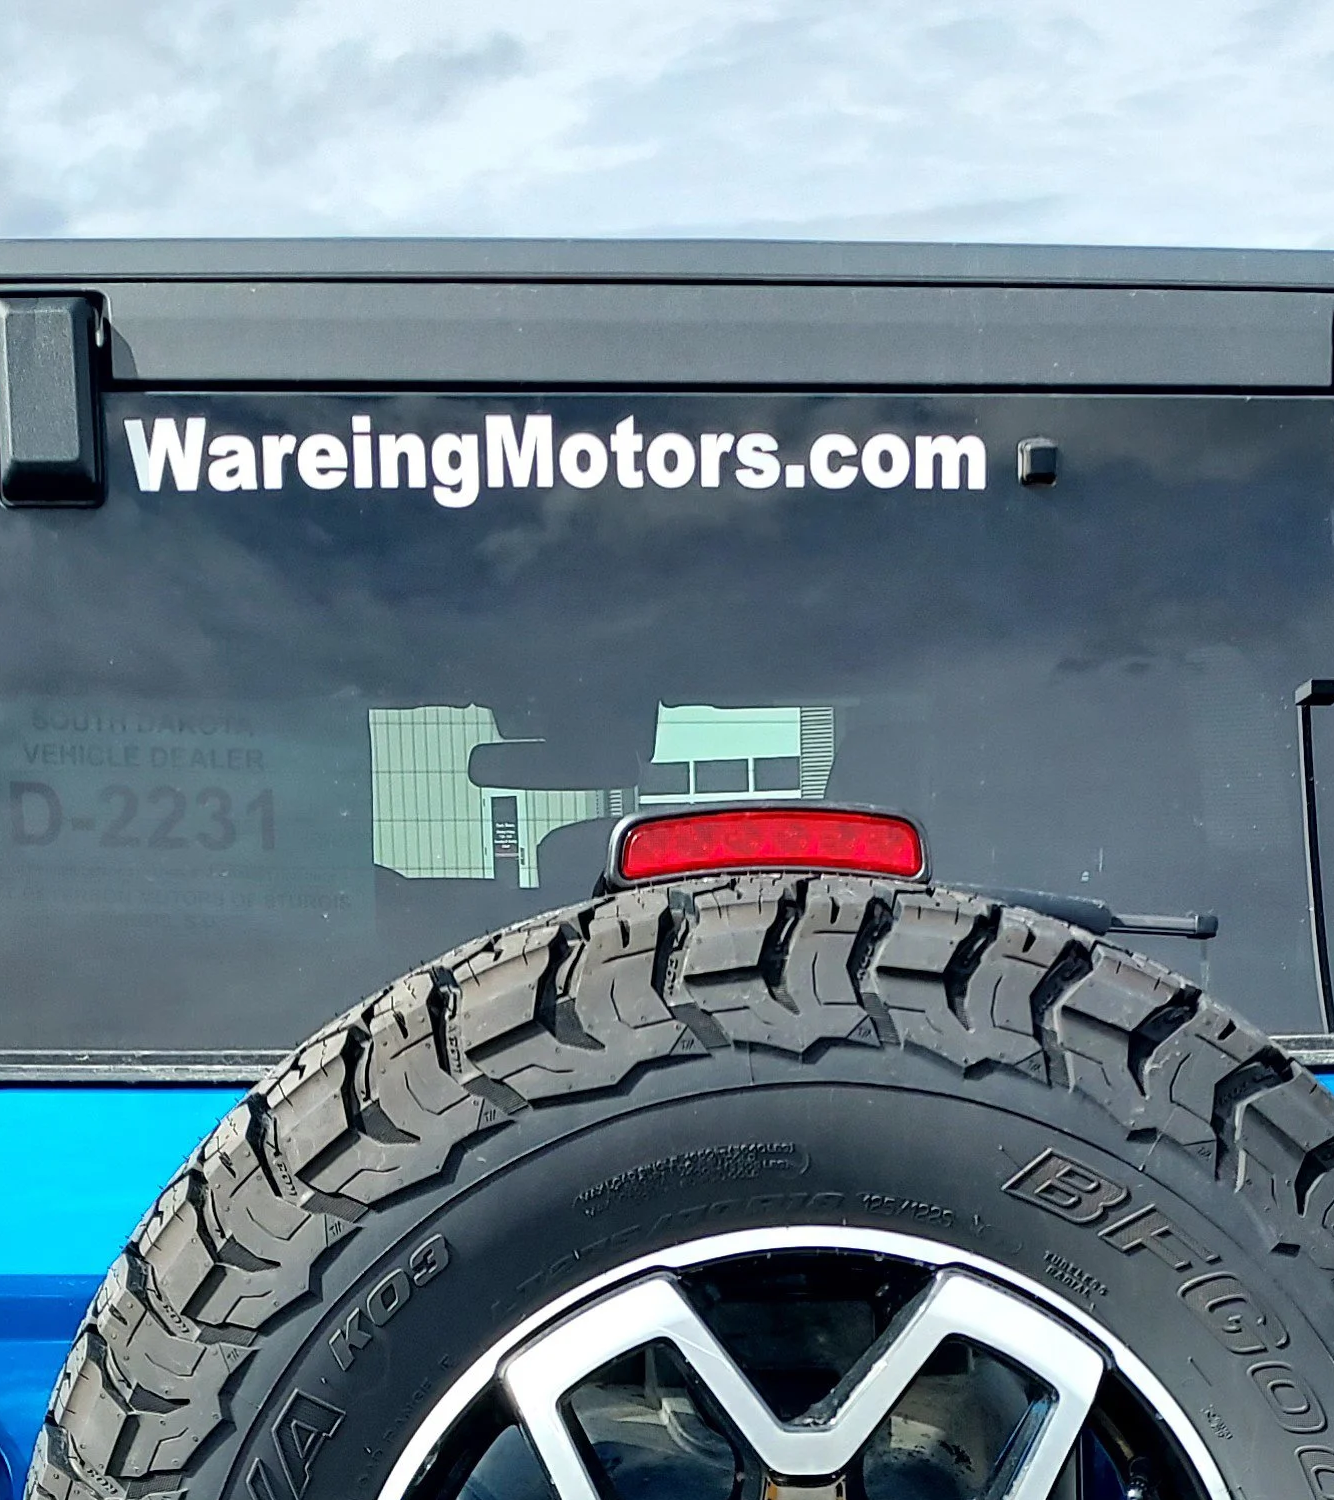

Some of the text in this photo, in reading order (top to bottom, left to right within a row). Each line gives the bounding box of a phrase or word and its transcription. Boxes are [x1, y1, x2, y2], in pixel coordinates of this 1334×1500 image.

[124, 413, 987, 508] WareingMotors.com
[23, 743, 265, 772] VEHICLE DEALER
[9, 780, 276, 851] D-2231
[328, 1234, 456, 1372] KO3
